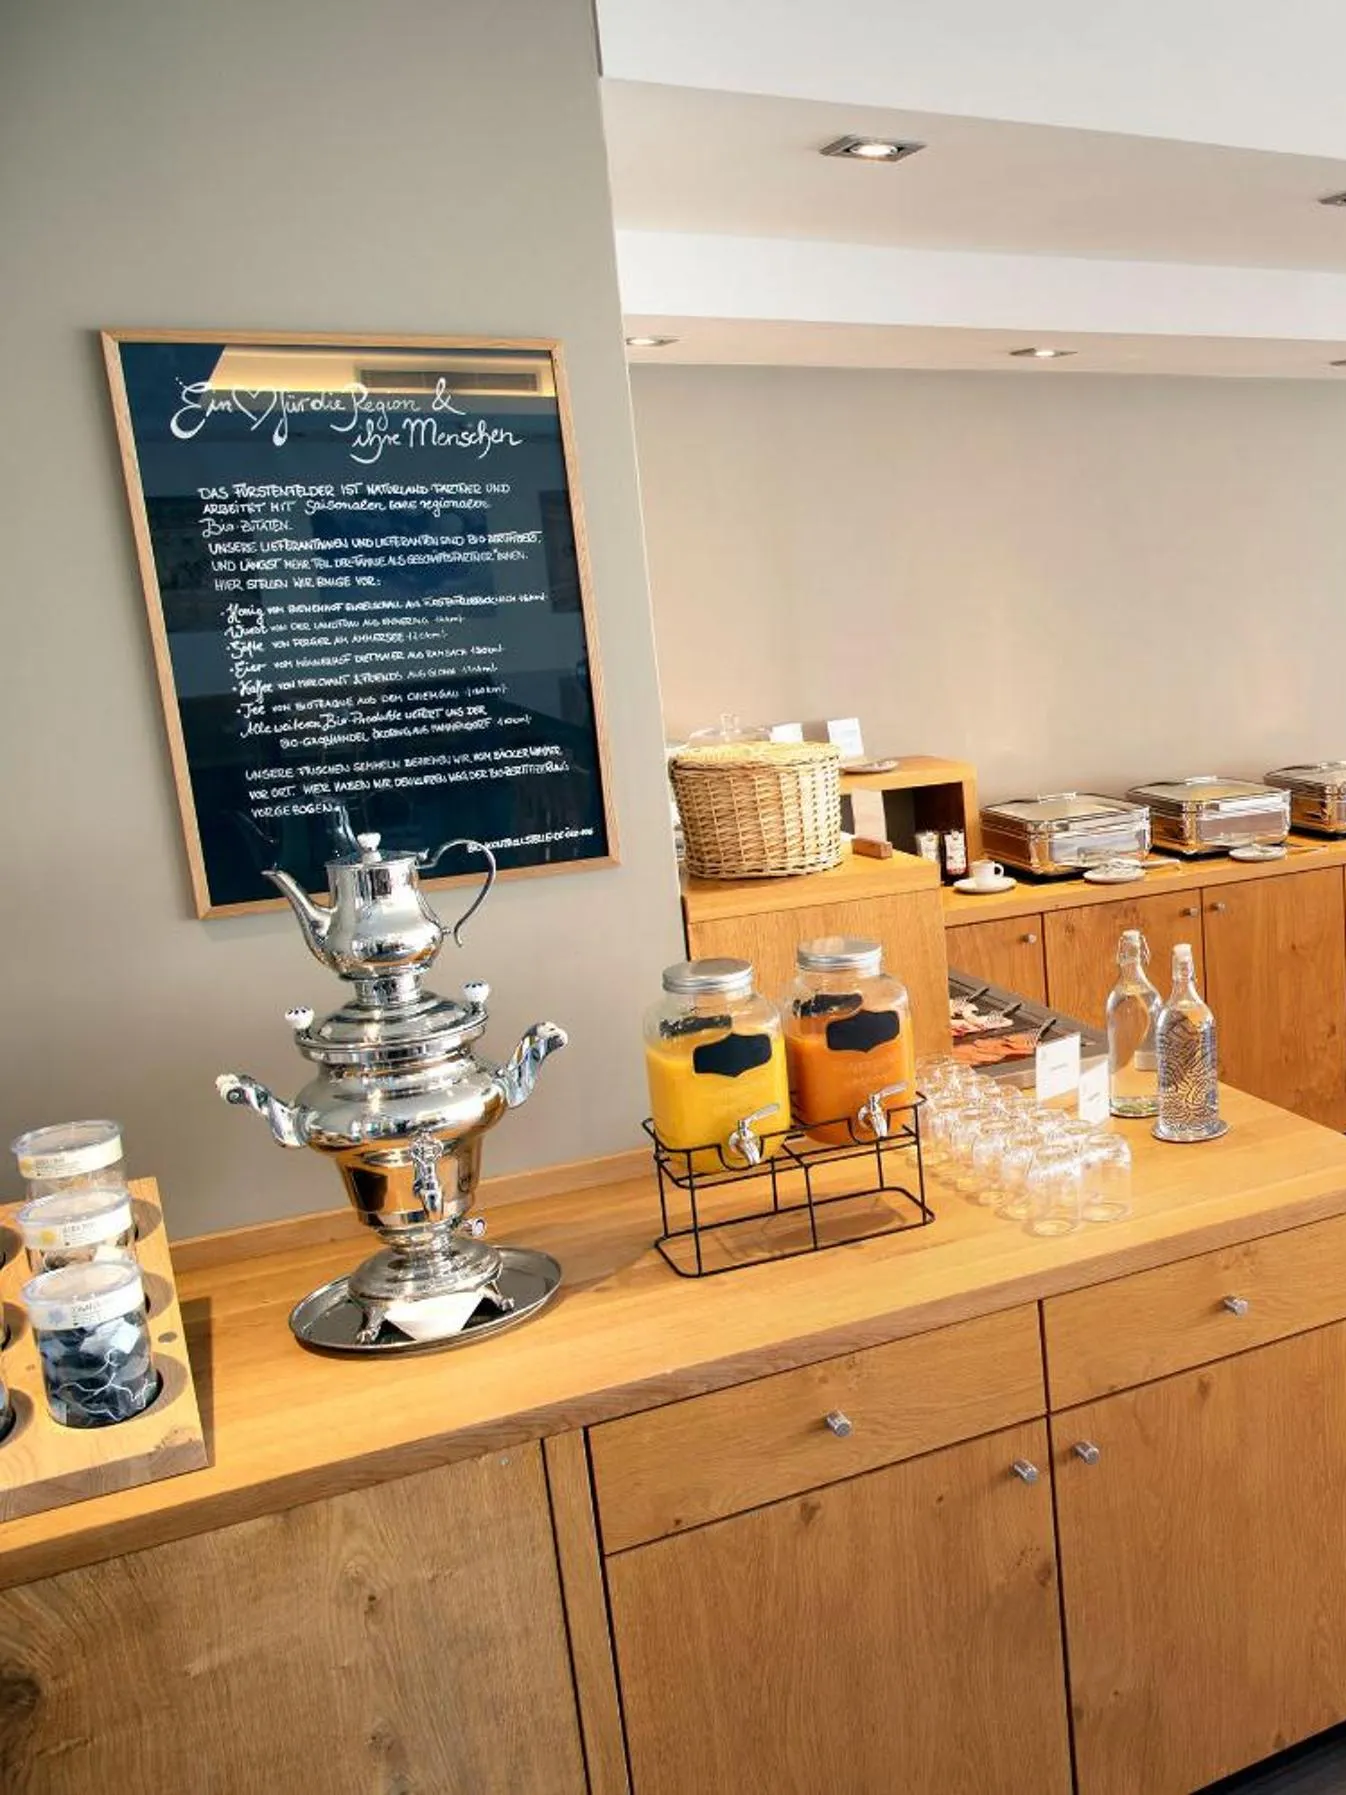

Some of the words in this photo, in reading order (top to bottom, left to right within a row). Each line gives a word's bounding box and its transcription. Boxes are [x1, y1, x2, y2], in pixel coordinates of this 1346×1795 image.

[170, 376, 233, 439] Ein
[273, 389, 307, 447] für
[310, 391, 346, 411] die
[331, 382, 421, 431] Region
[431, 377, 467, 415] &
[350, 419, 400, 464] ihre
[403, 417, 523, 460] Menschen
[198, 486, 229, 500] DAS
[233, 483, 335, 499] FÜRSTENFELDER
[340, 482, 363, 495] IST
[366, 483, 429, 497] NATURLAND
[431, 482, 483, 495] PARTNER
[486, 483, 511, 495] UND
[203, 500, 266, 515] ARBEITET
[270, 501, 297, 512] MIT
[208, 541, 258, 555] UNSERE
[351, 537, 374, 549] UND
[212, 560, 237, 572] UND
[283, 558, 311, 570] MEHR
[386, 556, 406, 568] ALS
[214, 579, 244, 592] HIER
[247, 578, 288, 590] STELLEN
[292, 576, 315, 589] WIR
[316, 576, 351, 588] EINIGE
[225, 603, 265, 625] Honig
[240, 703, 266, 718] Tee
[445, 705, 465, 718] UNS
[245, 767, 294, 781] UNSERE
[248, 790, 270, 801] VOR
